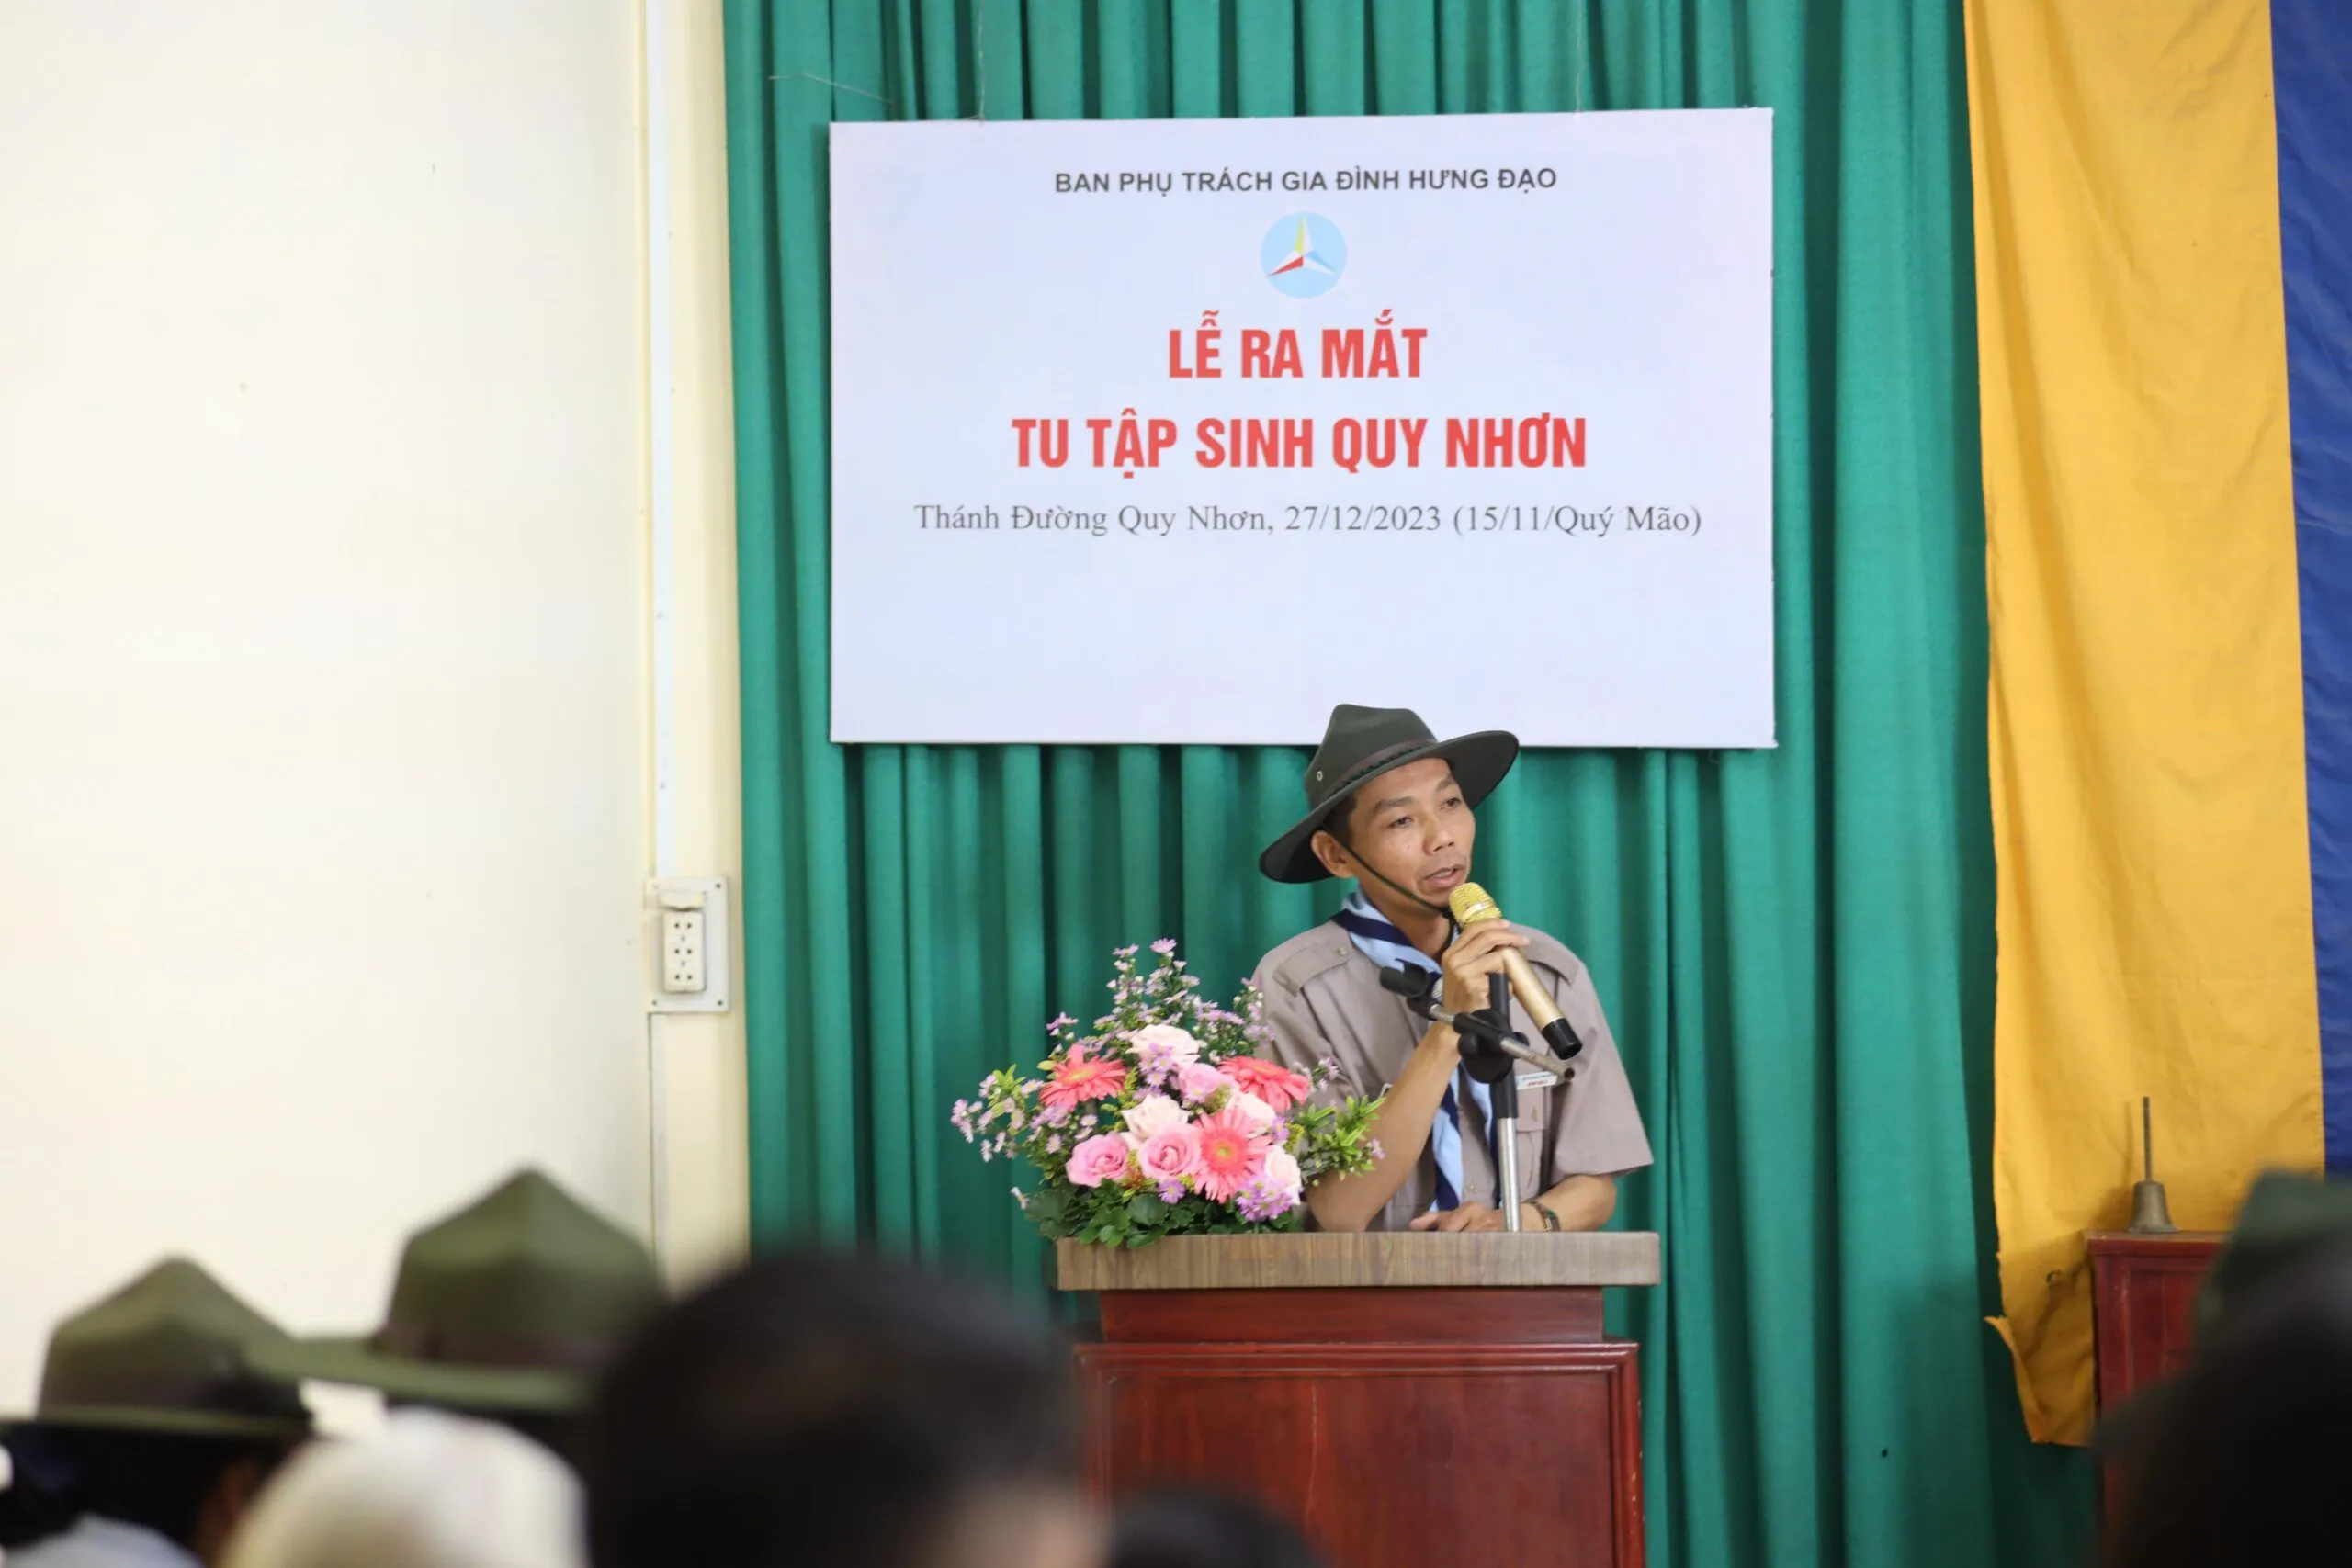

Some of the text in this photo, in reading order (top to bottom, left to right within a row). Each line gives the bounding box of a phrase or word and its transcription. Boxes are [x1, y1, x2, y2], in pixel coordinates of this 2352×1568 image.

[1056, 165, 1556, 197] BAN PHỤ TRÁCH GIA ĐÌNH HƯNG ĐẠO
[1169, 309, 1428, 378] LỄ RA MẮT
[1012, 407, 1586, 479] TU TẬP SINH QUY NHƠN
[915, 505, 1702, 537] Thánh Đường Quy Nhơn, 27/12/2023 (15/11/Quý Mão)
